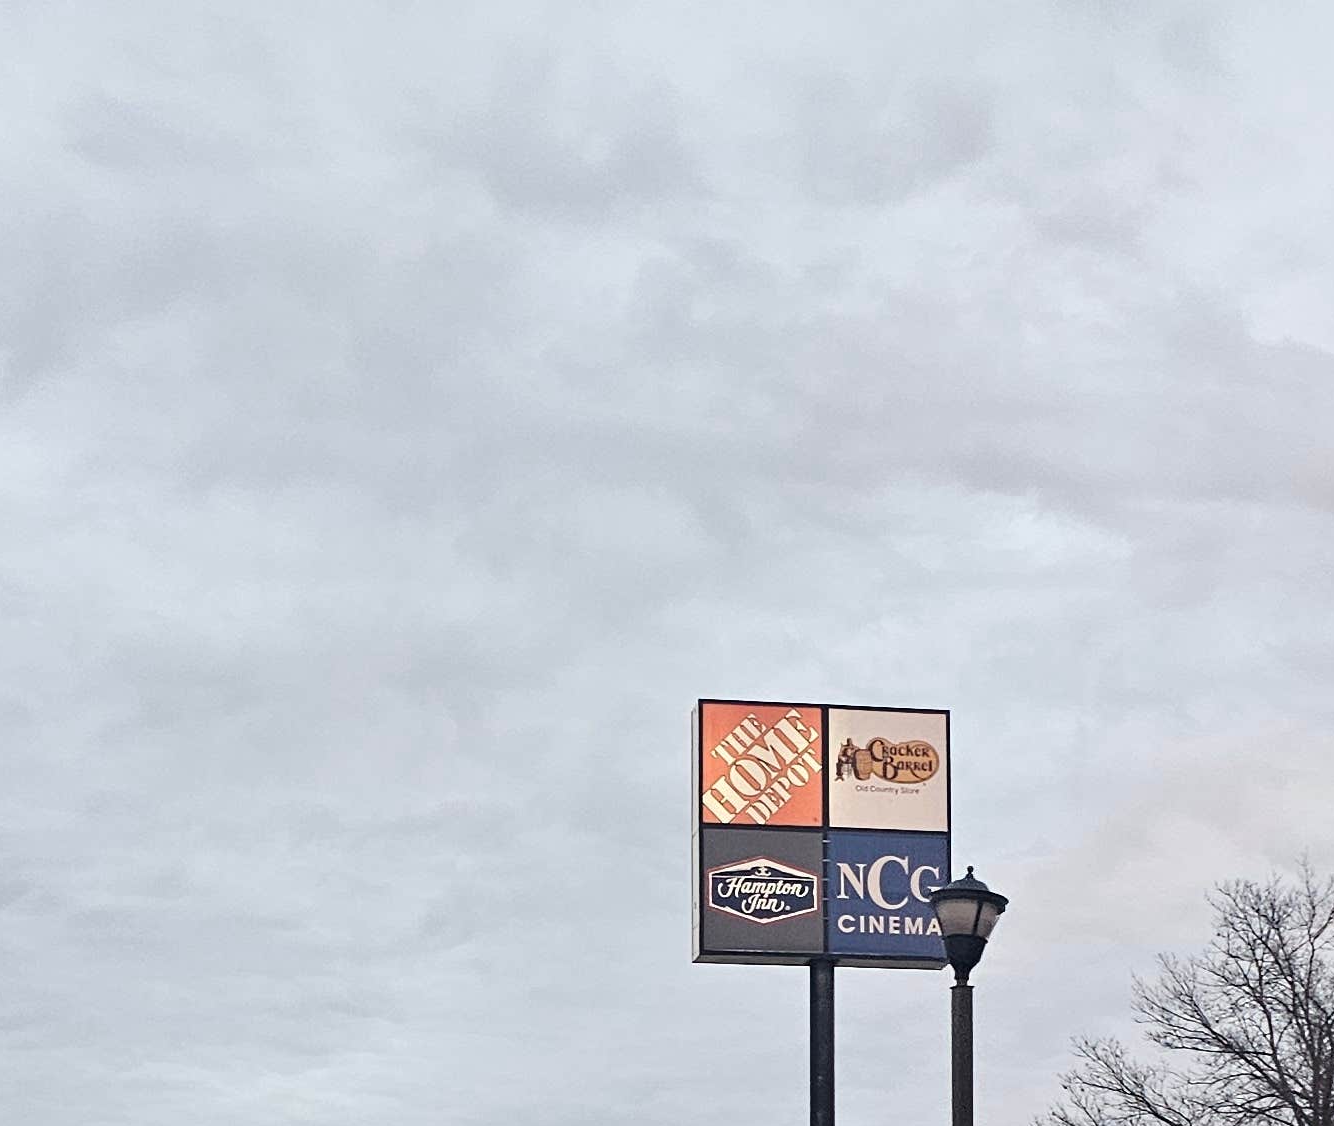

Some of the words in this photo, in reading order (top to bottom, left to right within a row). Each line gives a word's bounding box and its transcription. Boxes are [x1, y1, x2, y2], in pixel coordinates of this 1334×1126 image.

[710, 714, 767, 765] THE
[703, 709, 819, 824] HOME
[746, 748, 822, 824] DEPOT
[855, 784, 868, 793] Old
[869, 784, 898, 795] Country
[900, 786, 920, 795] Store
[717, 877, 809, 898] Hampton
[836, 855, 944, 910] NCG
[741, 893, 785, 914] Inn
[837, 914, 943, 936] CINEMA
